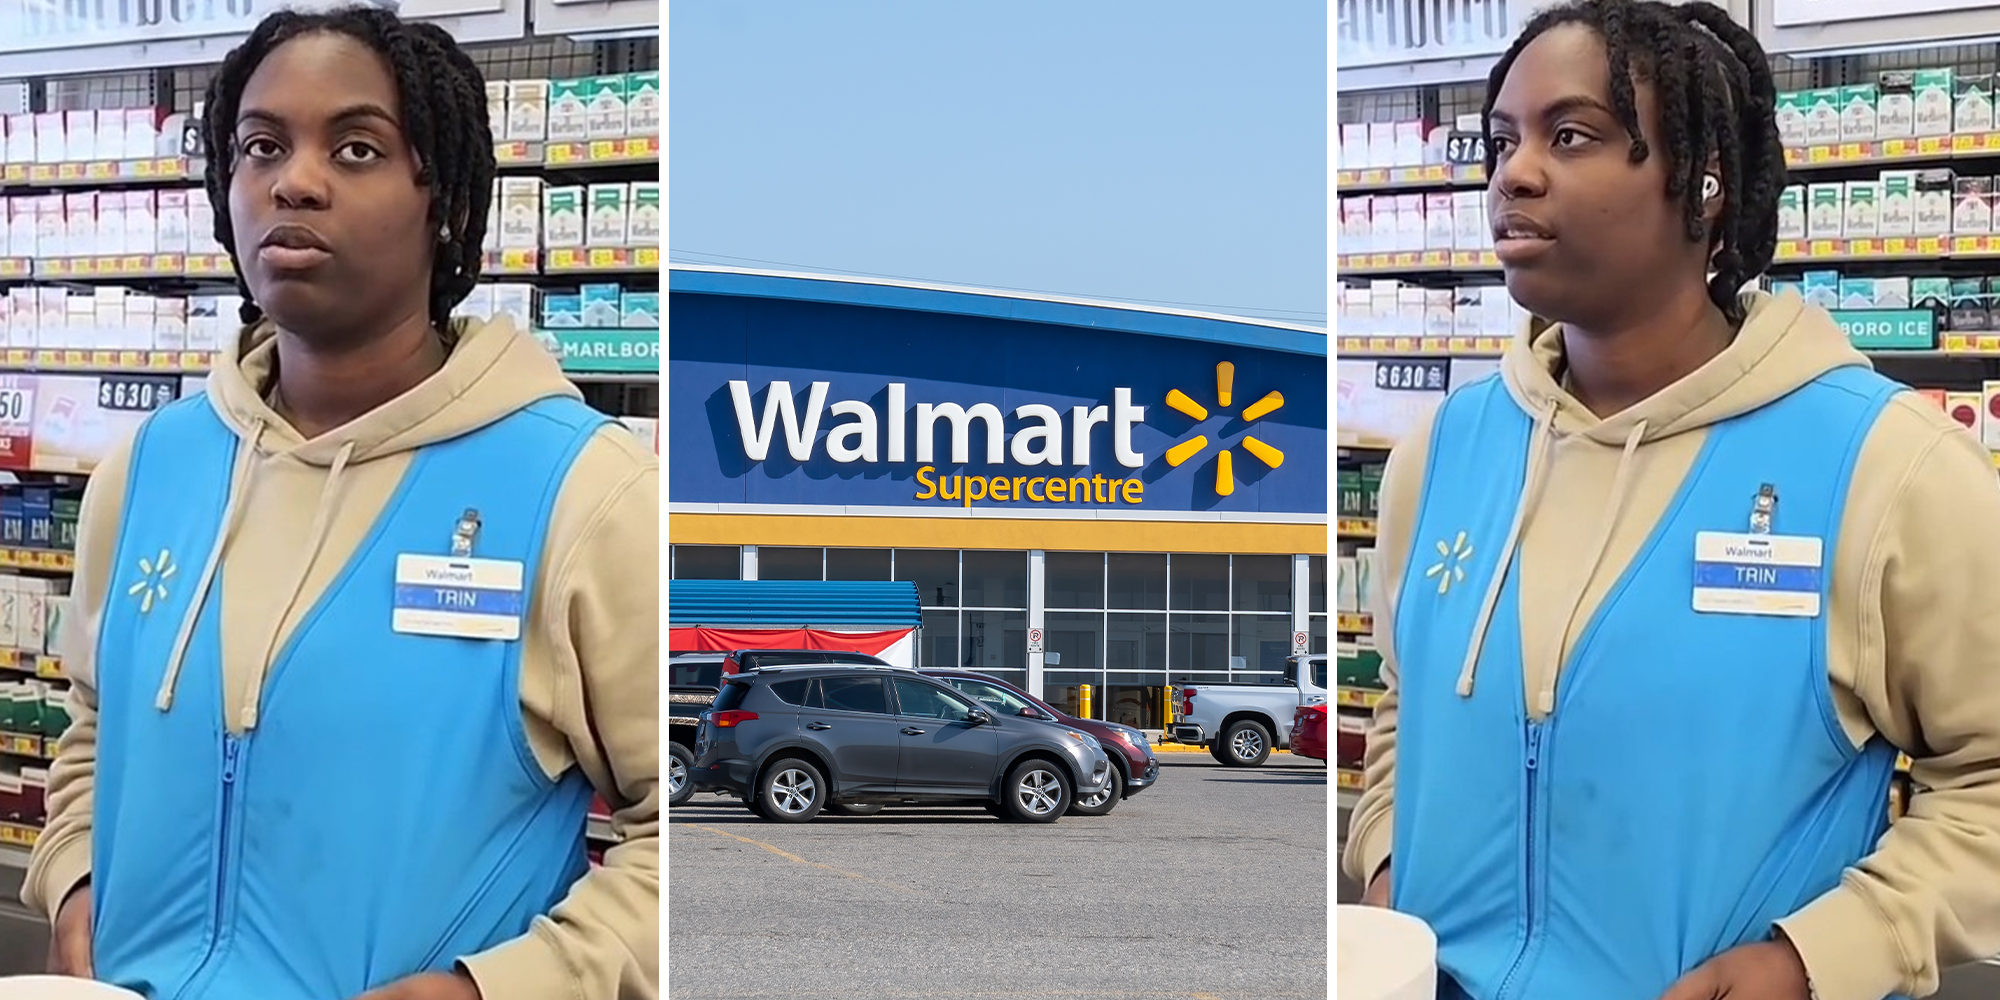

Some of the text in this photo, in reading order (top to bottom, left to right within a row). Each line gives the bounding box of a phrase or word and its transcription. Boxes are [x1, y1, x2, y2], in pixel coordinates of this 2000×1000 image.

[1898, 320, 1928, 336] ICE
[729, 380, 1145, 468] Walmart
[915, 466, 1144, 508] Supercentre
[1725, 546, 1773, 559] Walmart
[425, 569, 473, 582] Walmart
[1735, 567, 1777, 584] TRIN
[434, 589, 477, 607] TRIN
